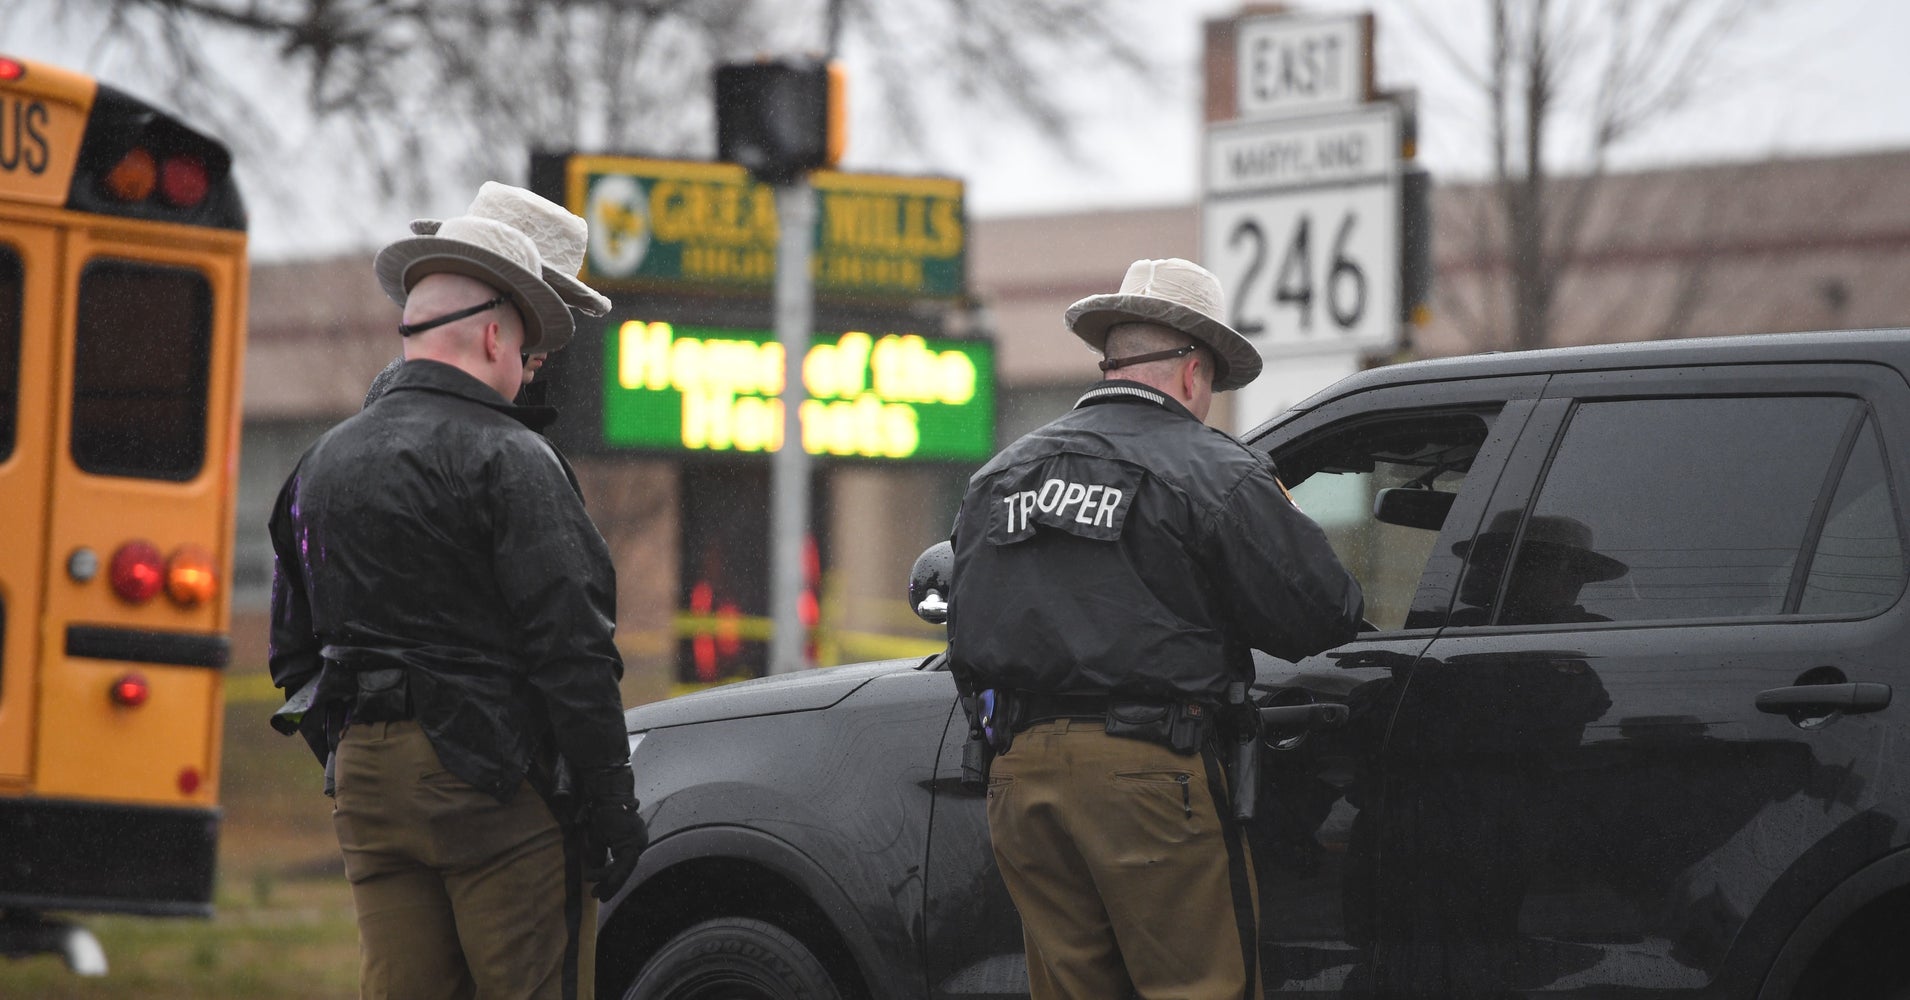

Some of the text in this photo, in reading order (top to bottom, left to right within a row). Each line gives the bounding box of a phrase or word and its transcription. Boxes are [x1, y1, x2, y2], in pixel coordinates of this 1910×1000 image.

[1254, 34, 1342, 102] EAST
[0, 100, 49, 175] US
[1228, 132, 1367, 177] MARYLAND
[648, 181, 964, 260] GREA MILLS
[1228, 211, 1367, 335] 246
[618, 320, 976, 405] Home of the
[1003, 478, 1123, 533] TROPER
